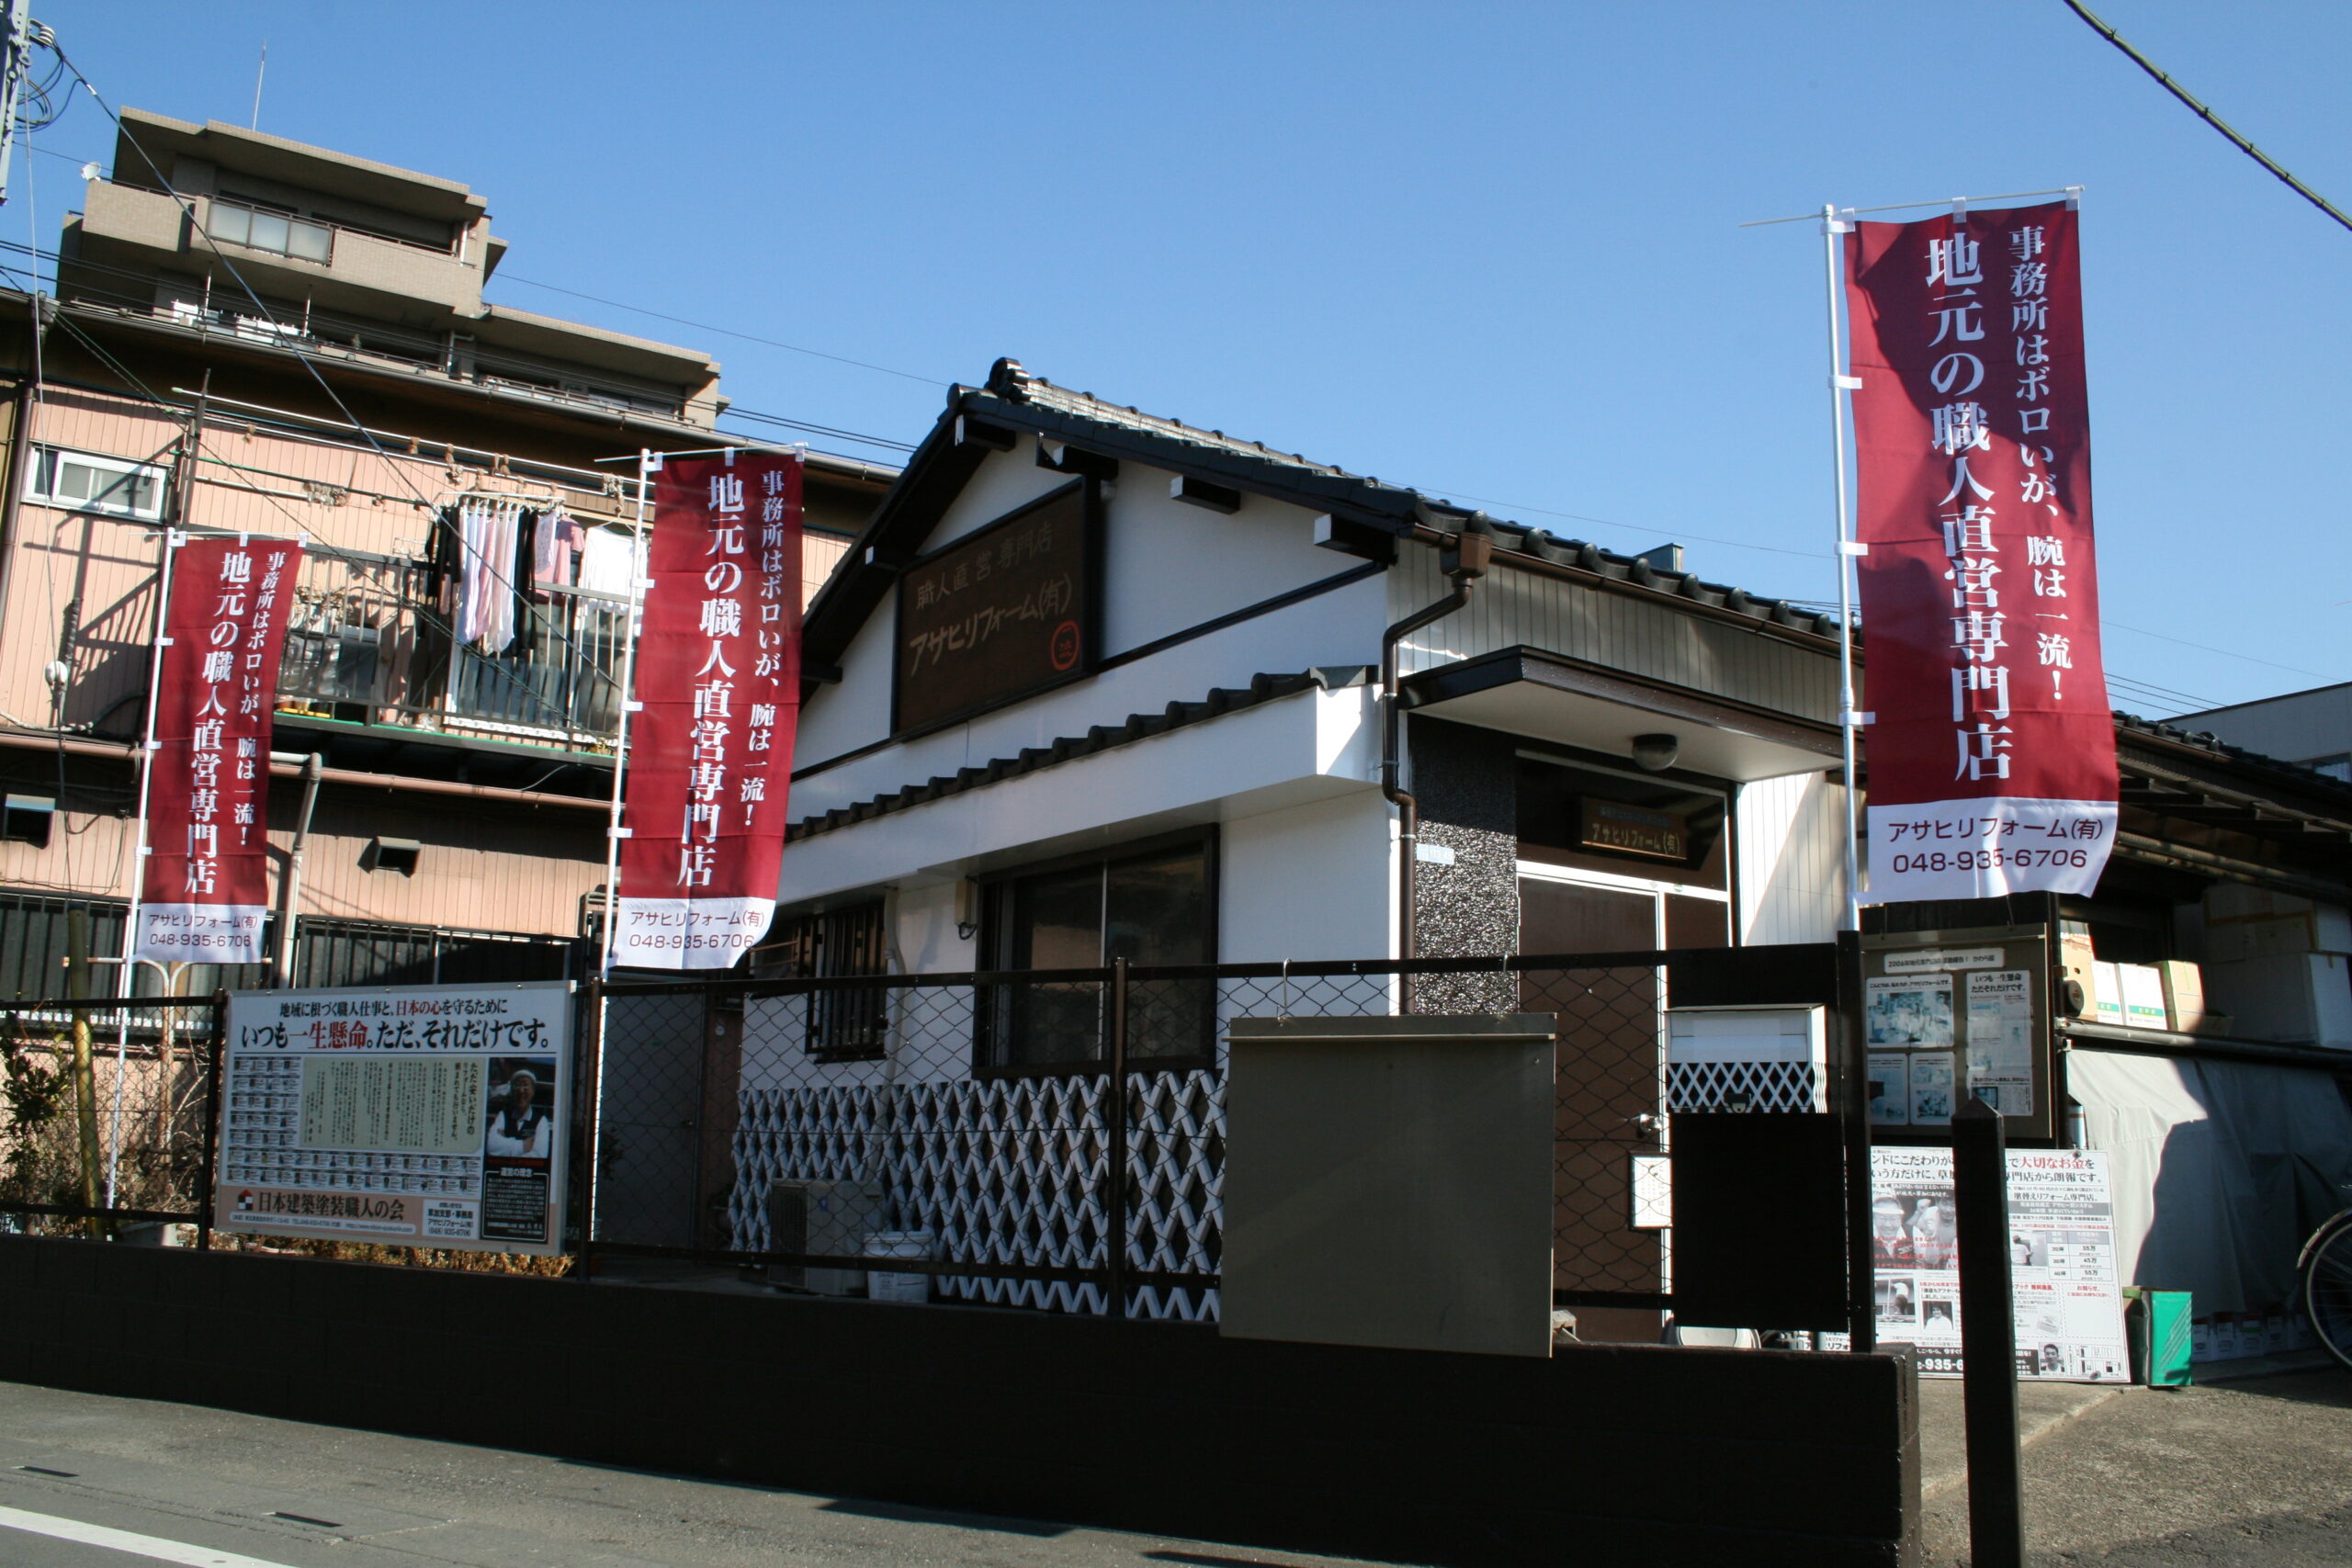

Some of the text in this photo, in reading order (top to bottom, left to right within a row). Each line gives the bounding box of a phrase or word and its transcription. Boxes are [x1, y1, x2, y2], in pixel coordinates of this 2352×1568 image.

[1925, 232, 2013, 782] 地元の職人直営専門店
[676, 473, 745, 887] 地元の職人直営専門店
[185, 551, 253, 894] 地元の職人直営専門店
[1888, 817, 2103, 842] アサヒリフォーム(有)
[1893, 849, 2087, 874] 048-935-6706
[149, 914, 258, 929] アサヒリフォーム(有)
[630, 910, 764, 928] アサヒリフォーム(有)
[149, 933, 251, 947] 048-935-6706
[629, 934, 755, 948] 048-935-6706
[242, 1020, 548, 1050] いつも一生懸命。ただ、それだけです。
[2006, 1156, 2095, 1169] で大切なお金を
[258, 1191, 404, 1221] 日本建築塗装職人の会
